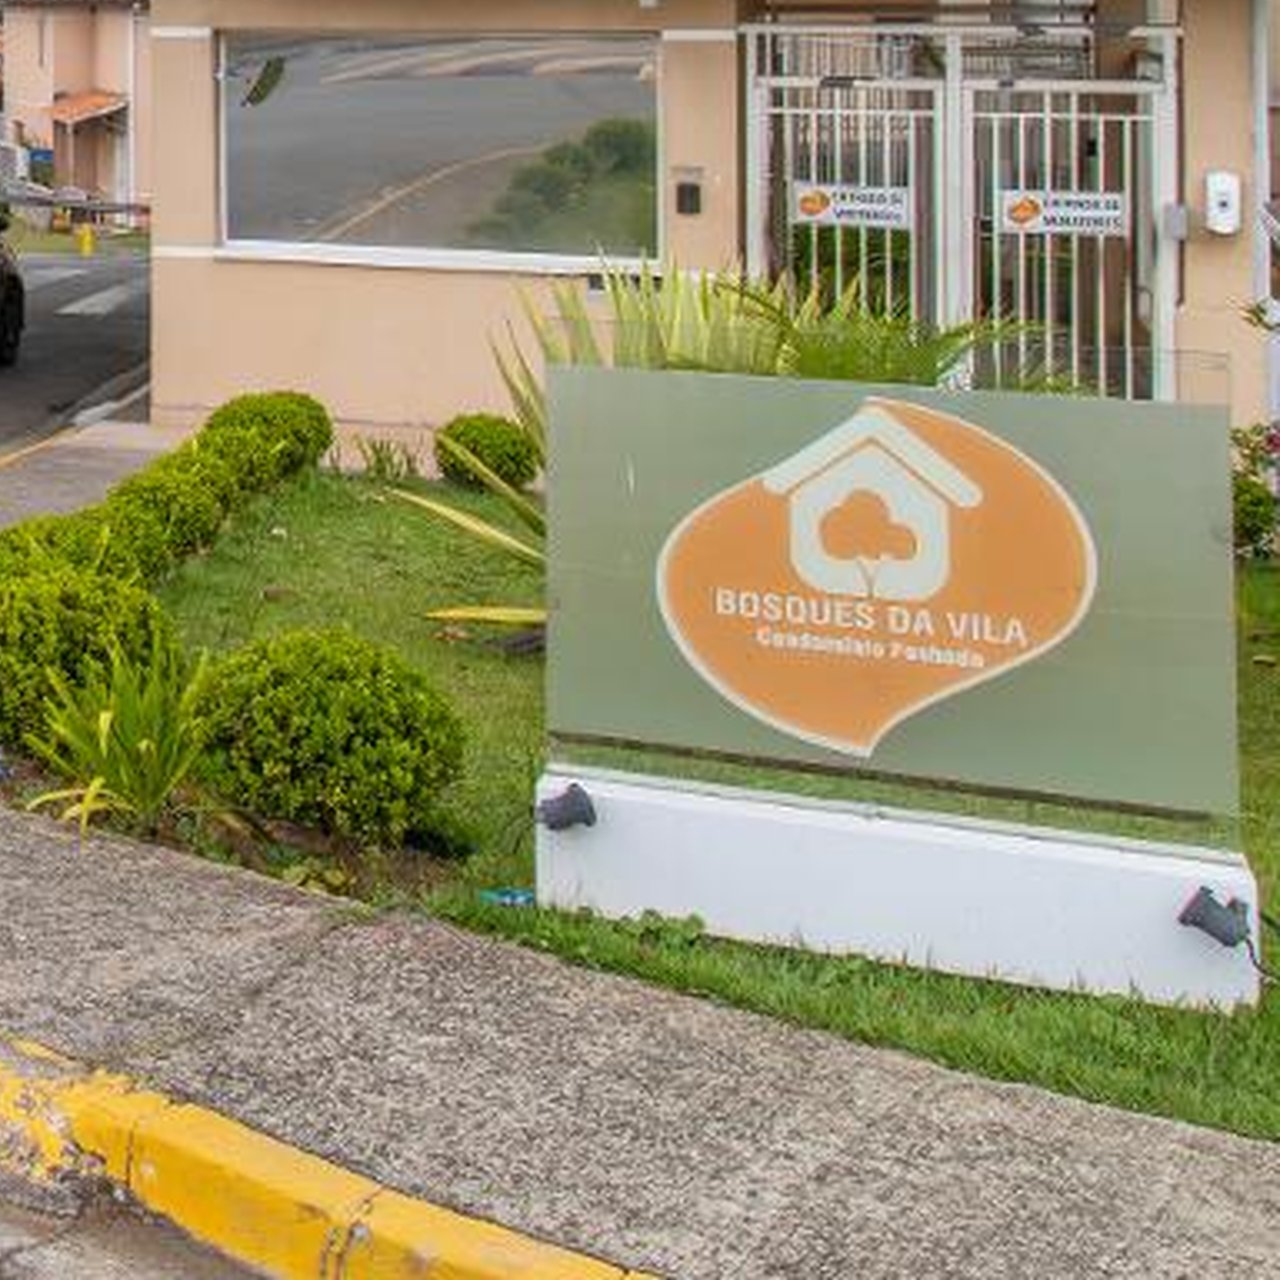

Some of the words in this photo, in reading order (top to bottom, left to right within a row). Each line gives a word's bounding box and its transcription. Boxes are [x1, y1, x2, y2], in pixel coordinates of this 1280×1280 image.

[714, 587, 876, 631] BOSQUES
[886, 605, 935, 637] DA
[944, 611, 1030, 648] VILA
